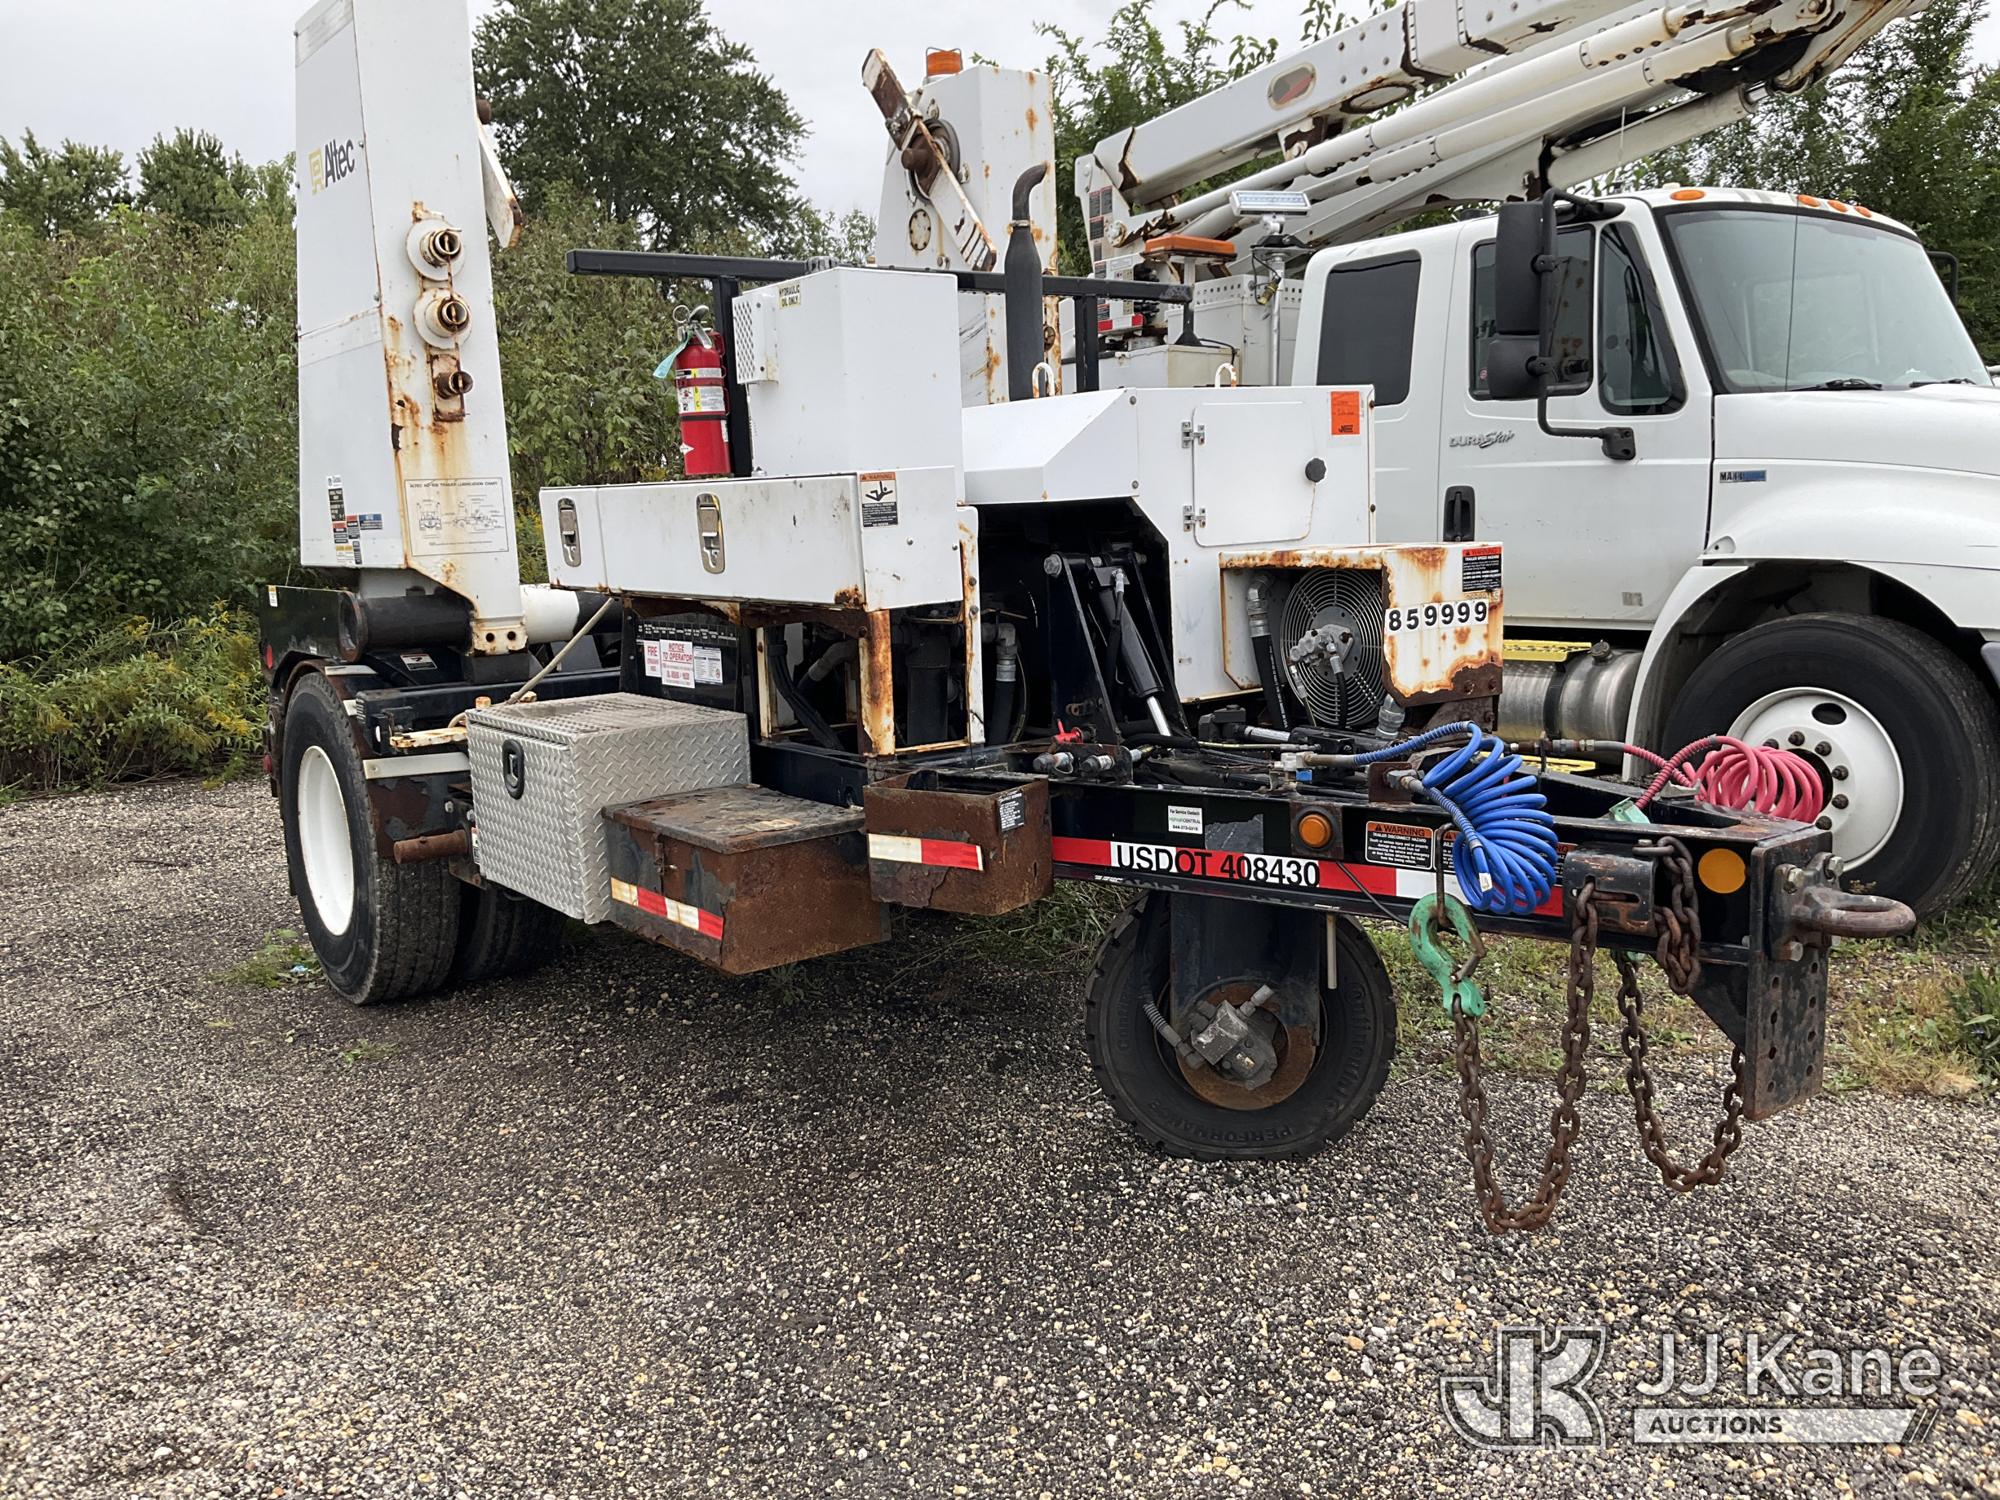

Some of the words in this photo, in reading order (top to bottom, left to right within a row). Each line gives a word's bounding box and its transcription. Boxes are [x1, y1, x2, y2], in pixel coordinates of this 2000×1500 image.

[325, 138, 355, 188] Altec
[1389, 601, 1487, 631] 859999
[1384, 824, 1425, 836] WARNING
[1116, 844, 1212, 877] USDOT
[1220, 854, 1321, 888] 408430
